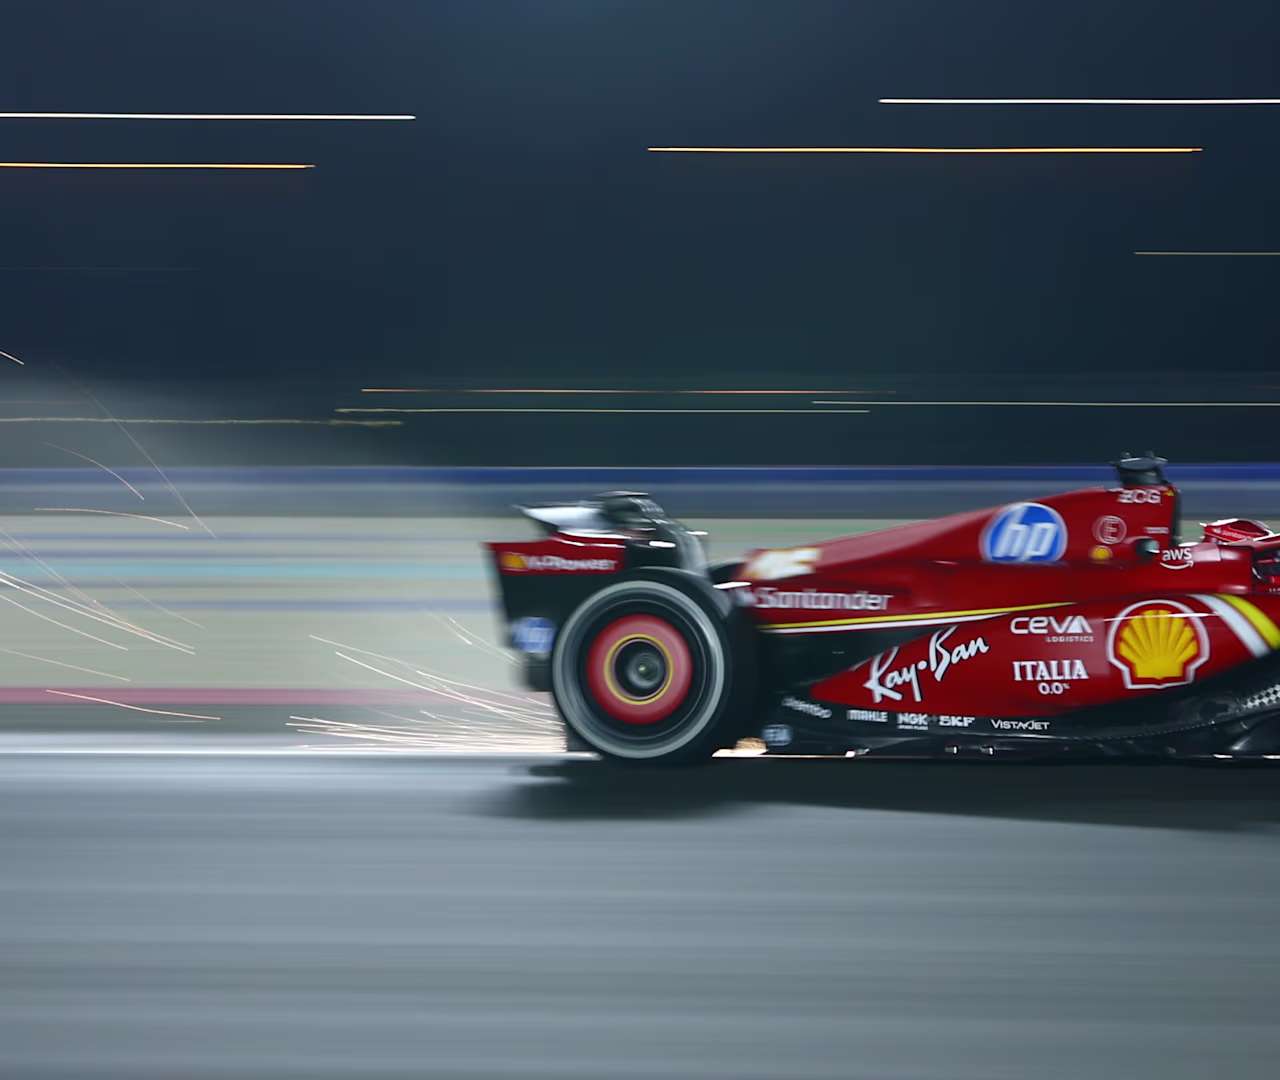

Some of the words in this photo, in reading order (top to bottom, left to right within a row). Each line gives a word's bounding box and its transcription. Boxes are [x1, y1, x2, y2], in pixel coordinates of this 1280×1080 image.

[988, 504, 1060, 562] hp
[1162, 548, 1192, 561] aws
[754, 587, 895, 610] Santander
[1012, 660, 1090, 681] ITALIA
[897, 712, 928, 725] NGK
[939, 715, 975, 727] SKF
